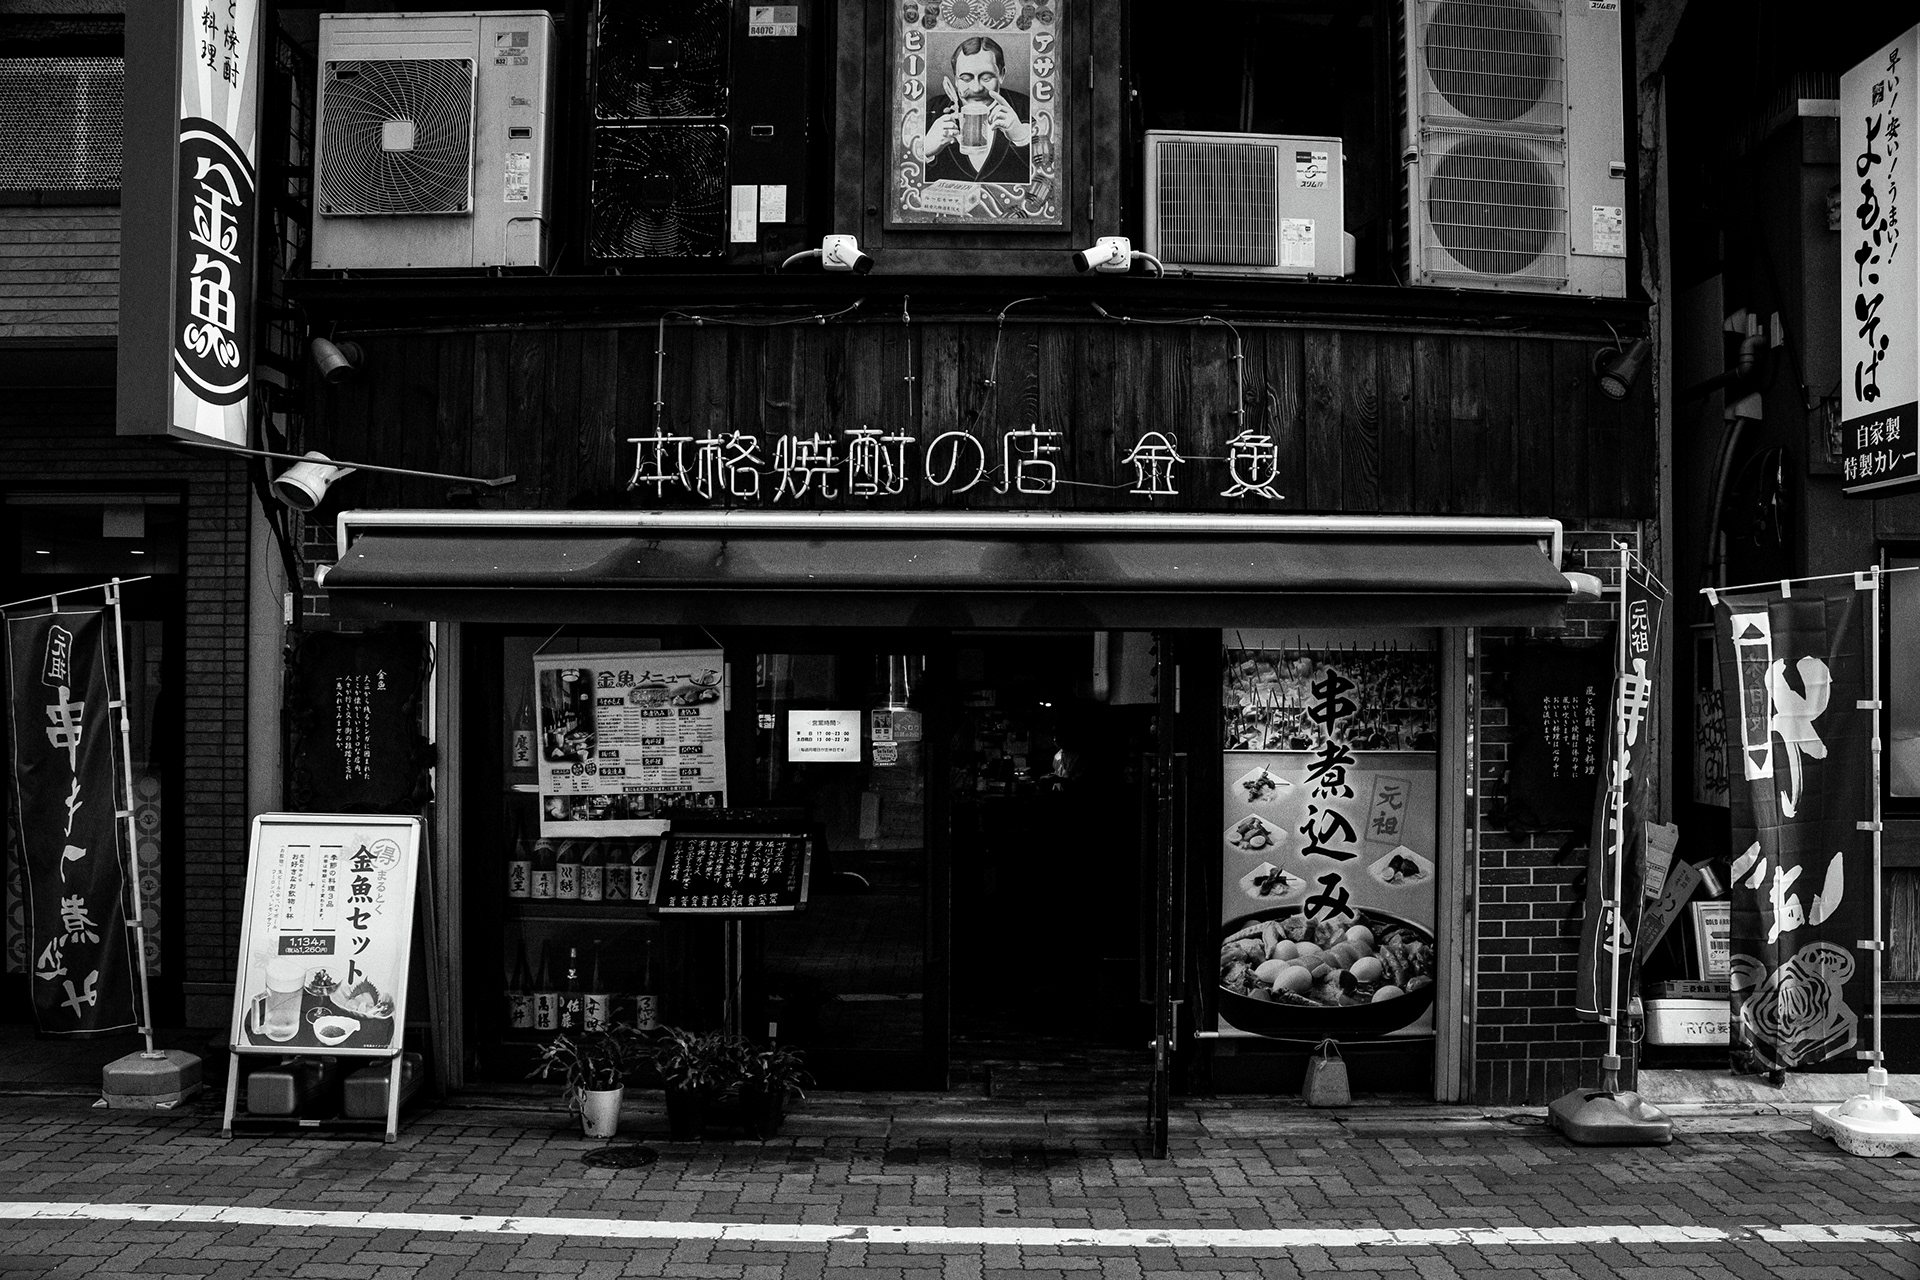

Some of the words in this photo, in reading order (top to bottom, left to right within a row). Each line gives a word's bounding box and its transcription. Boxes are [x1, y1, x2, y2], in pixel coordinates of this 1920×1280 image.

[750, 26, 774, 35] R407C
[903, 30, 925, 100] ビール
[1033, 33, 1055, 101] アサヒ
[183, 156, 243, 369] 金魚
[1855, 112, 1890, 403] よもだそば
[1857, 416, 1900, 449] 自家製
[627, 424, 1063, 502] 本格焼酎の店
[1121, 429, 1285, 500] 金魚
[1844, 449, 1917, 481] 特製カレー
[1631, 607, 1649, 653] 元祖
[597, 670, 636, 689] 金魚
[637, 670, 692, 684] メニュー
[515, 735, 529, 762] 魔王
[1585, 686, 1596, 775] 風と焼酎、水と料理
[1300, 669, 1358, 922] 串煮込み
[1373, 786, 1402, 836] 元祖
[326, 854, 338, 907] 季節の料理3品
[375, 870, 388, 915] まるとく
[511, 865, 525, 892] 魔王
[346, 844, 378, 985] 金魚セット
[1683, 985, 1710, 993] 三菱食品
[1714, 985, 1730, 993] 要回
[561, 999, 580, 1028] 佐藤
